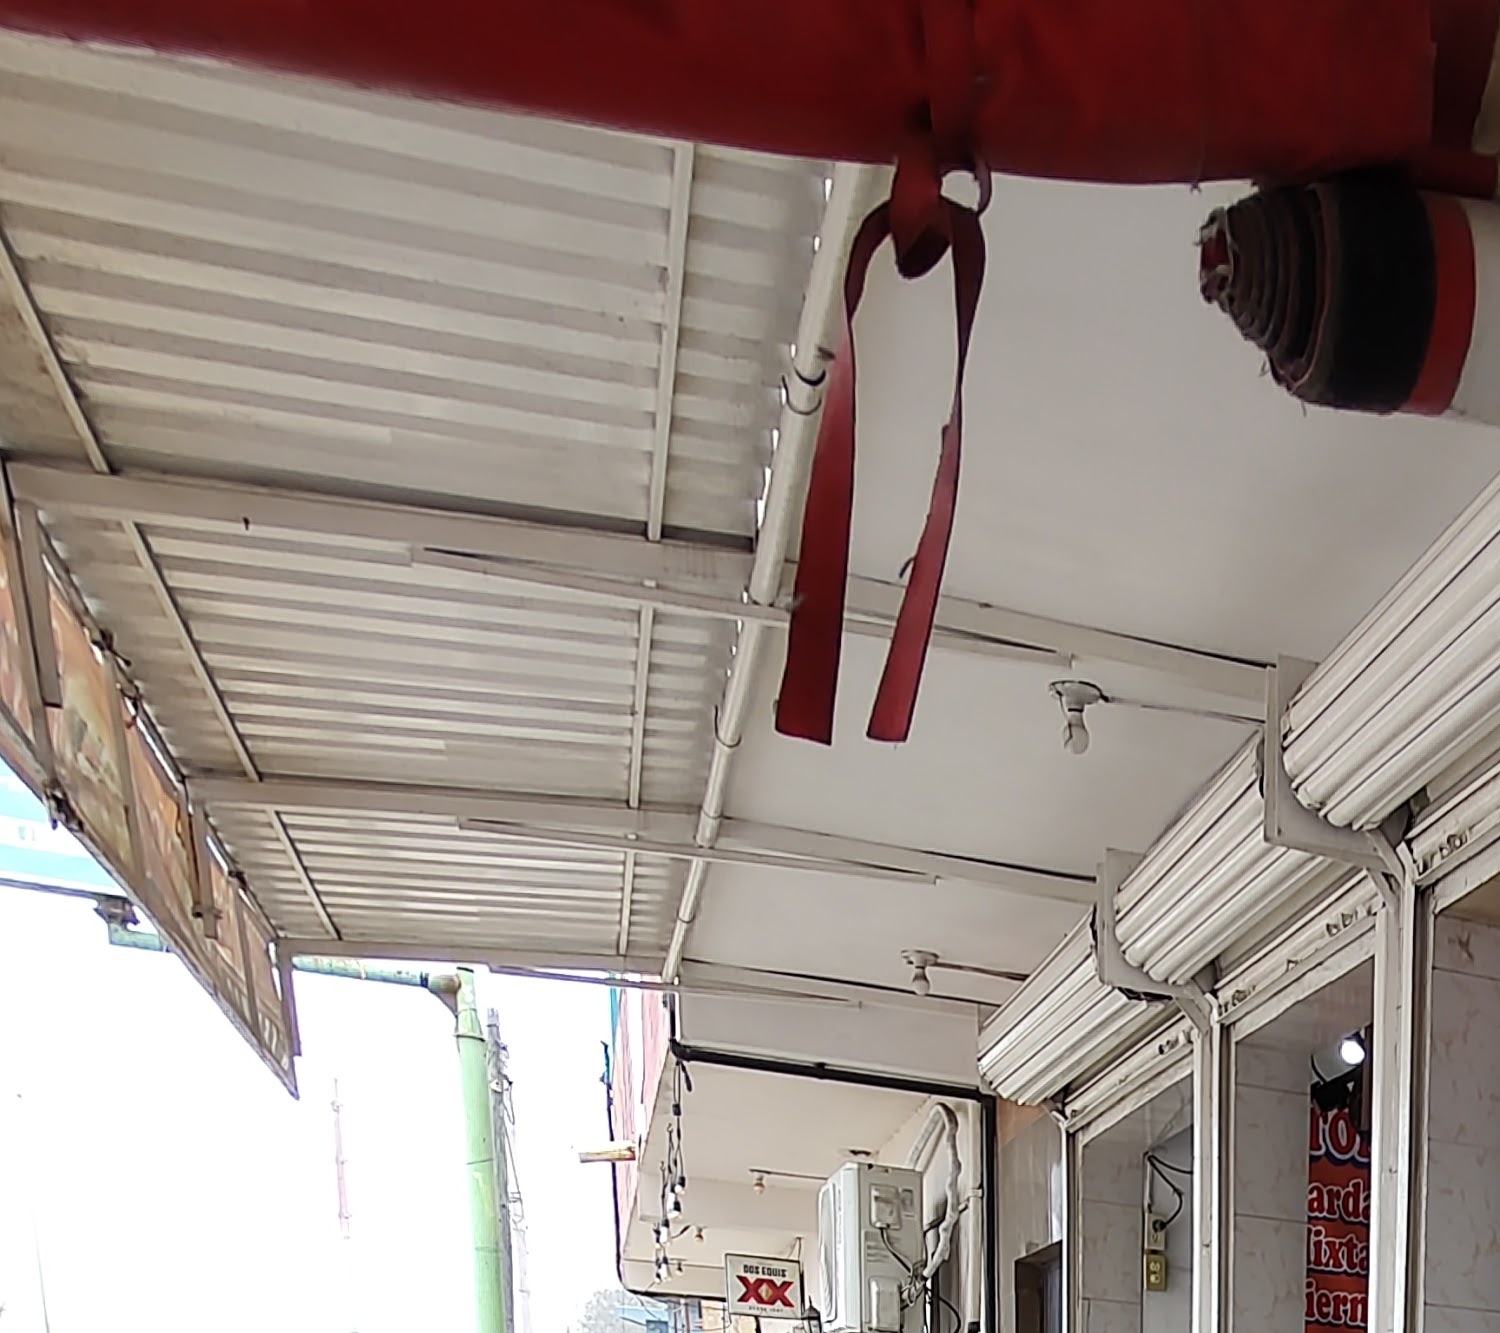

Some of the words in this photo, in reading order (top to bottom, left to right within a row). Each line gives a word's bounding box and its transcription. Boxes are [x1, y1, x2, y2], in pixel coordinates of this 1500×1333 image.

[743, 1264, 760, 1275] DOS
[762, 1266, 787, 1278] EQUIS
[736, 1275, 795, 1308] XX
